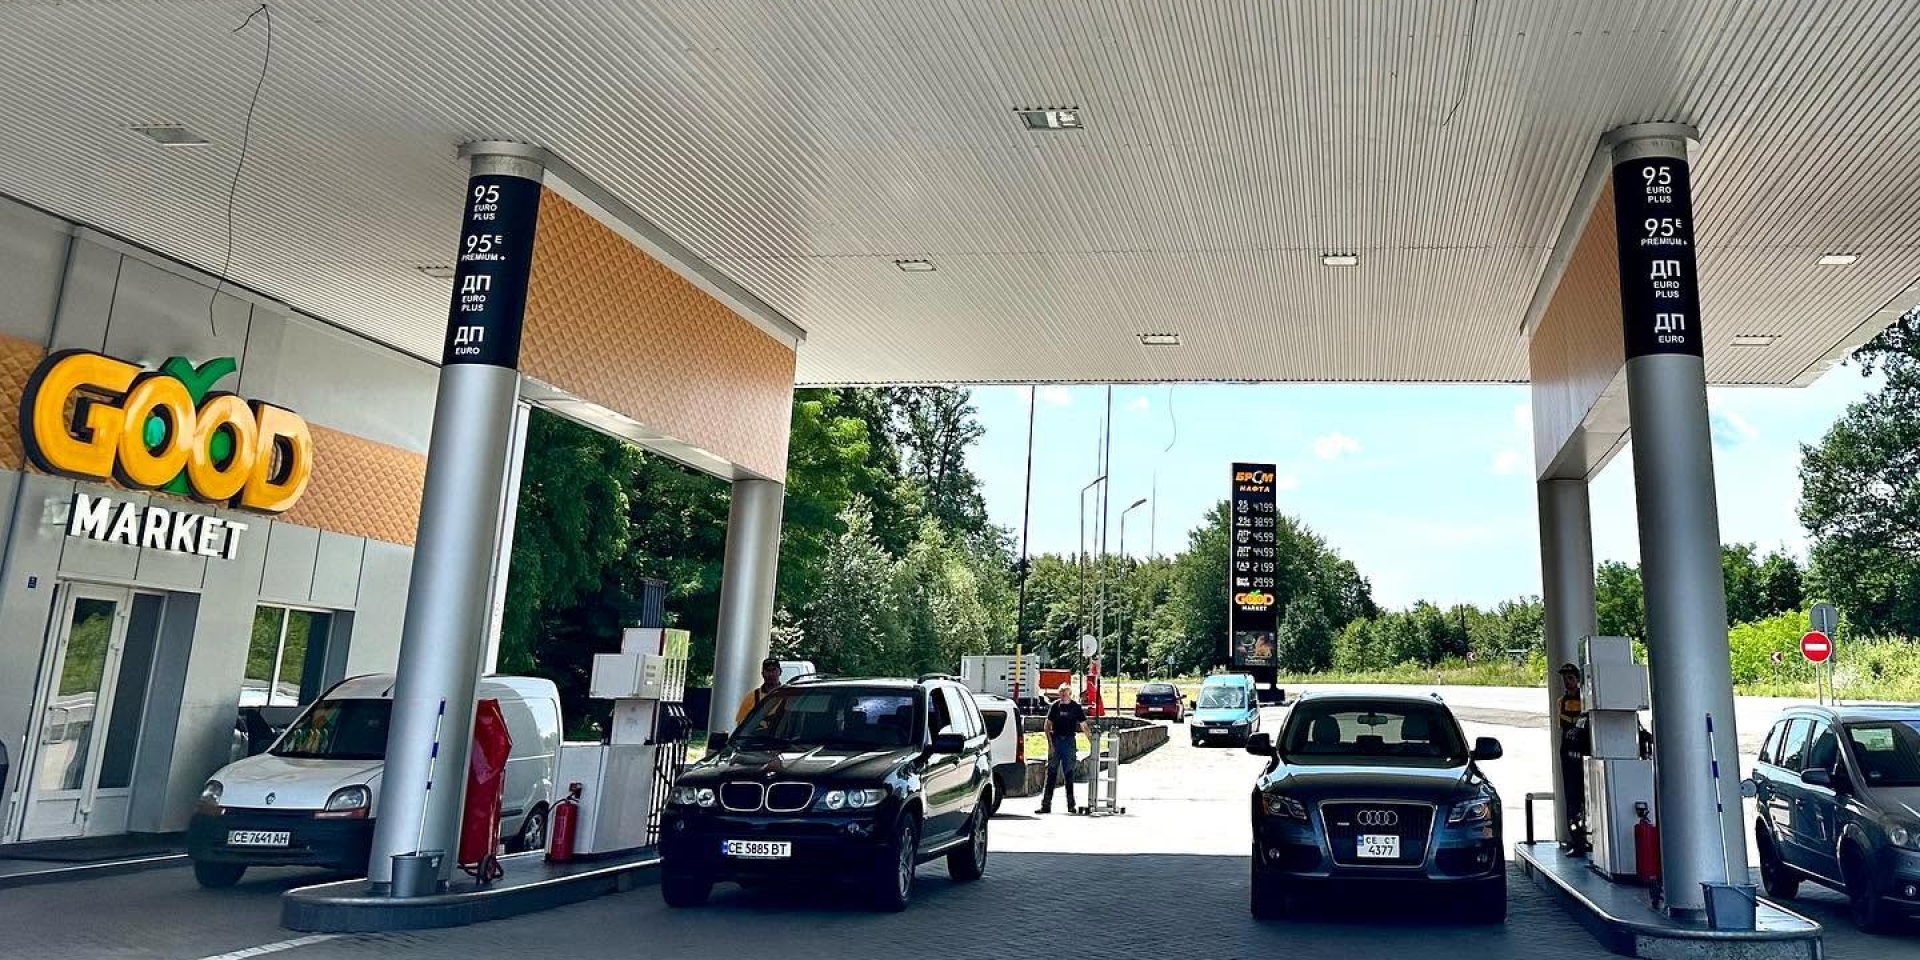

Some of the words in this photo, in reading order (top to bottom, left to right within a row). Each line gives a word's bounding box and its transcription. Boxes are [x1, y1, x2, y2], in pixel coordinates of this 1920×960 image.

[1642, 166, 1672, 186] 95
[474, 185, 500, 204] 95
[1646, 186, 1672, 194] EURO
[1647, 196, 1672, 204] PLUS
[473, 204, 498, 212] EURO
[472, 212, 496, 221] PLUS
[1650, 260, 1681, 280] ДП
[461, 275, 491, 293] ДП
[1653, 281, 1680, 289] EURO
[461, 295, 486, 303] EURO
[1655, 290, 1680, 298] PLUS
[461, 303, 484, 312] PLUS
[1654, 313, 1685, 333] ДП
[454, 326, 485, 345] ДП
[1658, 335, 1685, 343] EURO
[455, 347, 481, 355] EURO
[20, 348, 313, 513] GOOD
[1239, 485, 1270, 493] НАФТА
[70, 493, 248, 560] MARKET
[1235, 593, 1275, 605] GOOD
[235, 832, 248, 843] CE
[250, 832, 272, 844] 7641
[273, 833, 288, 844] AH
[729, 842, 743, 854] CE
[745, 843, 769, 855] 5885
[771, 844, 787, 855] BT
[1368, 845, 1393, 856] 4377
